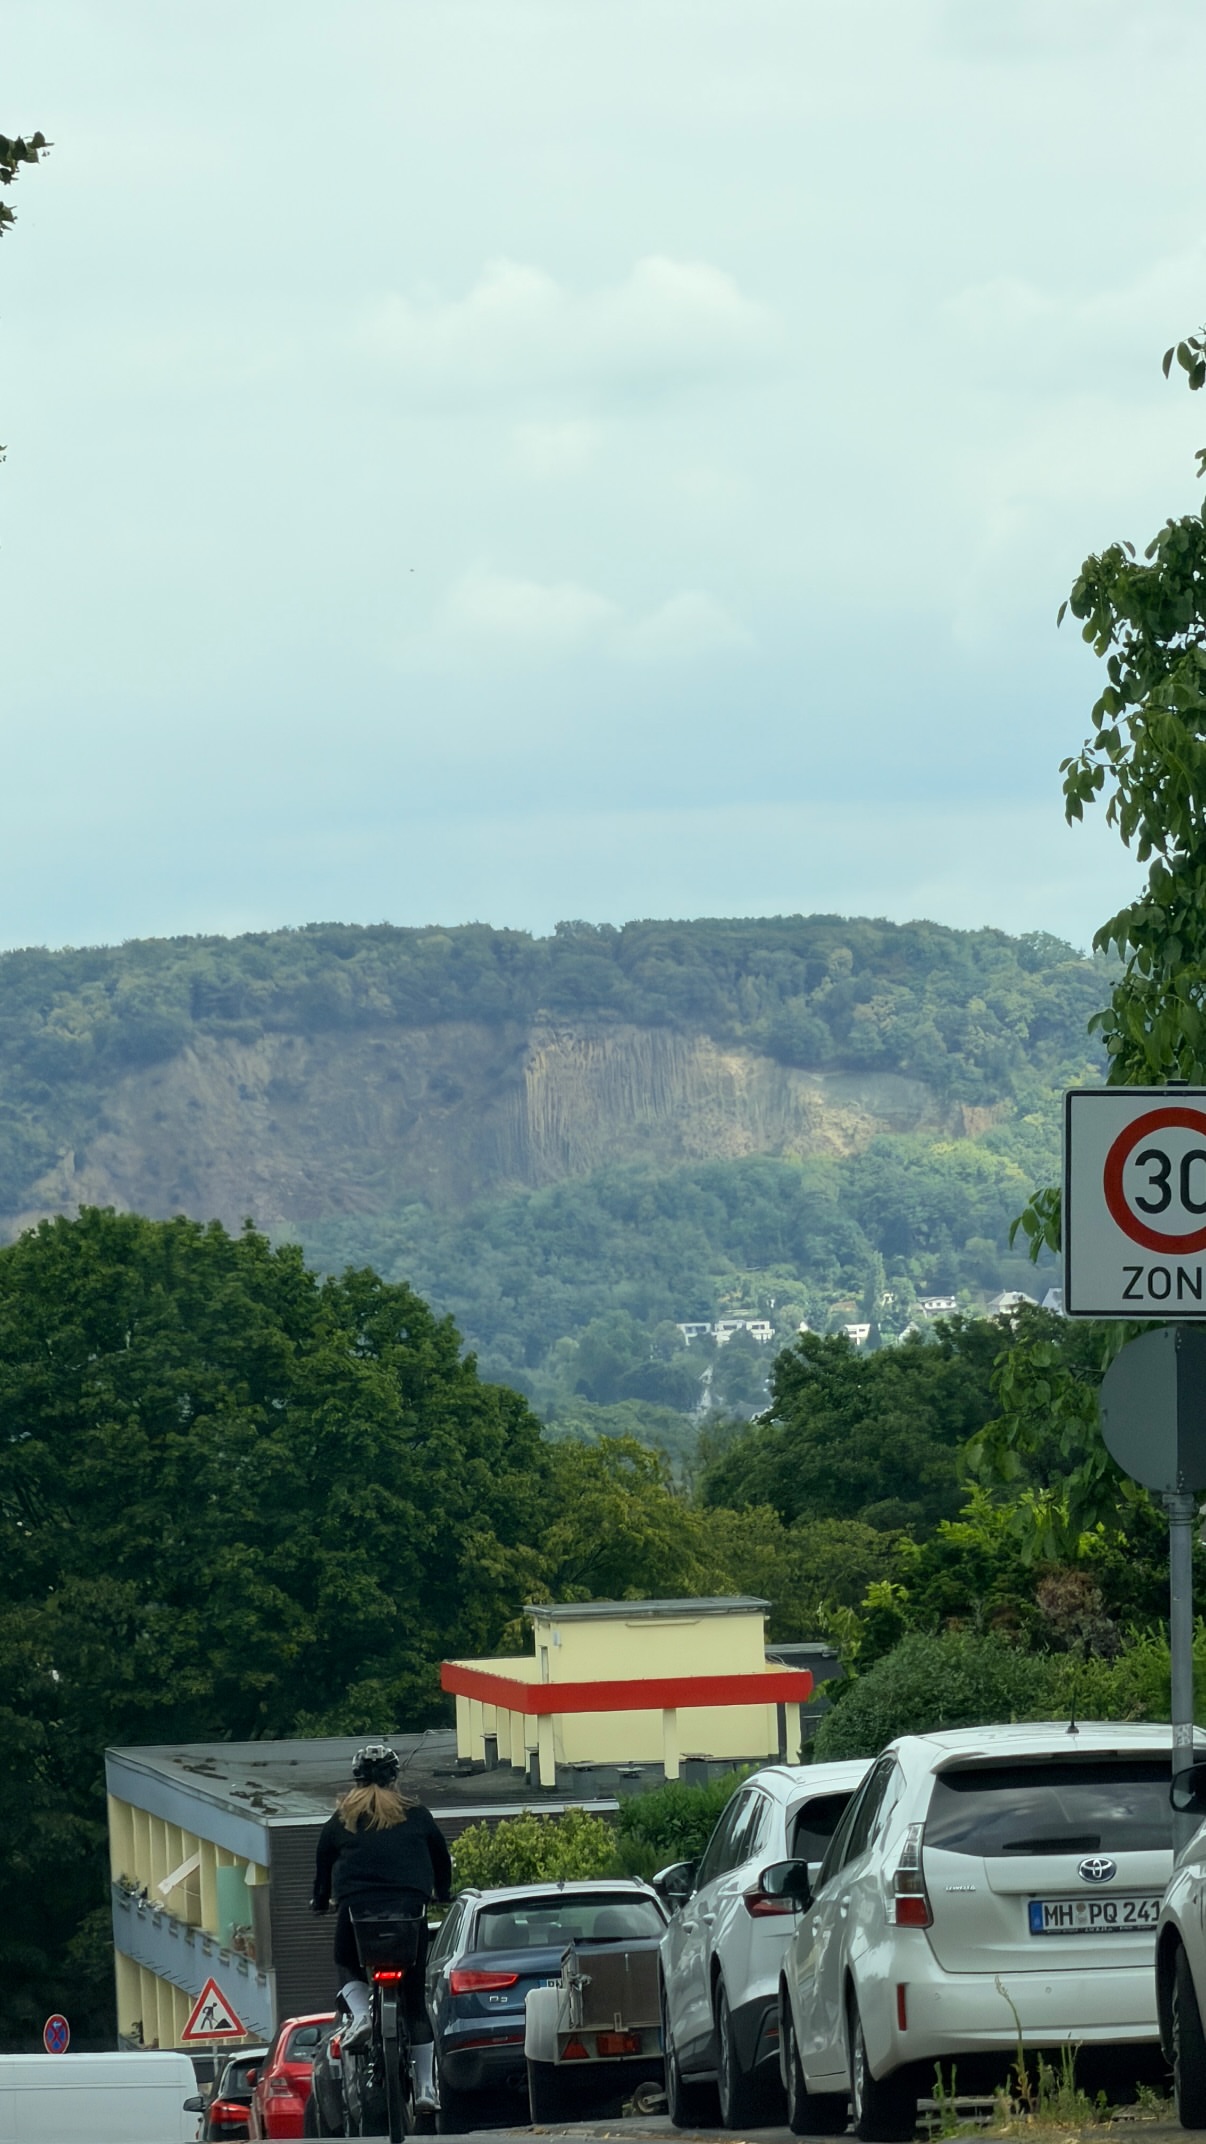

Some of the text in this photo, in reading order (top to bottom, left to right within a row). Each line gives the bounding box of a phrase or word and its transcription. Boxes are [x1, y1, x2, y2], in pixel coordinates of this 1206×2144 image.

[1134, 1148, 1206, 1215] 30
[1122, 1266, 1203, 1300] ZON
[1043, 1903, 1074, 1927] MH
[1088, 1902, 1118, 1925] PQ
